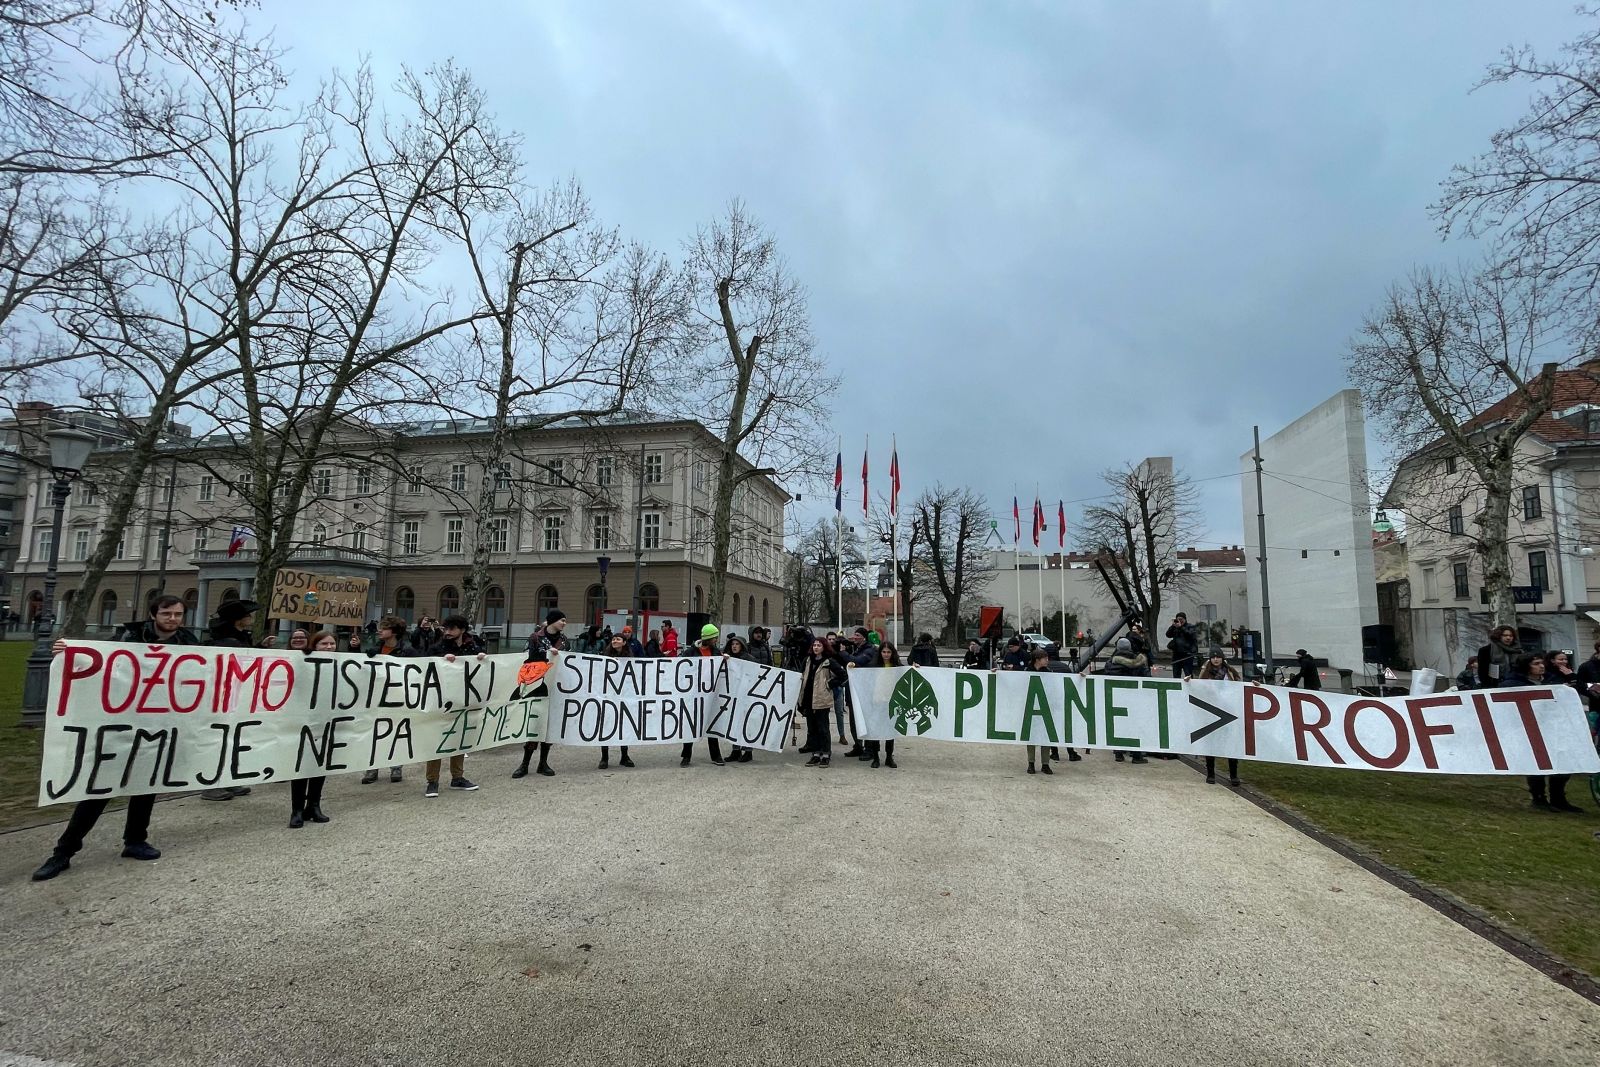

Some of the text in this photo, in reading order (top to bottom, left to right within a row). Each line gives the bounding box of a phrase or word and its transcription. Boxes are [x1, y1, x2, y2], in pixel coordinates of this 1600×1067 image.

[271, 588, 300, 613] ČAS
[322, 600, 363, 618] DEJANJA
[275, 570, 316, 589] DOST
[57, 645, 495, 716] POŽGIMO TISTEGA, KI
[557, 655, 785, 704] STRATEGIJA ZA
[47, 699, 543, 799] JEMLJE, NE PA ZEMLJE
[560, 694, 793, 750] PODNEBNI ZLOM
[954, 672, 1182, 749] PLANET
[1243, 685, 1555, 771] PROFIT
